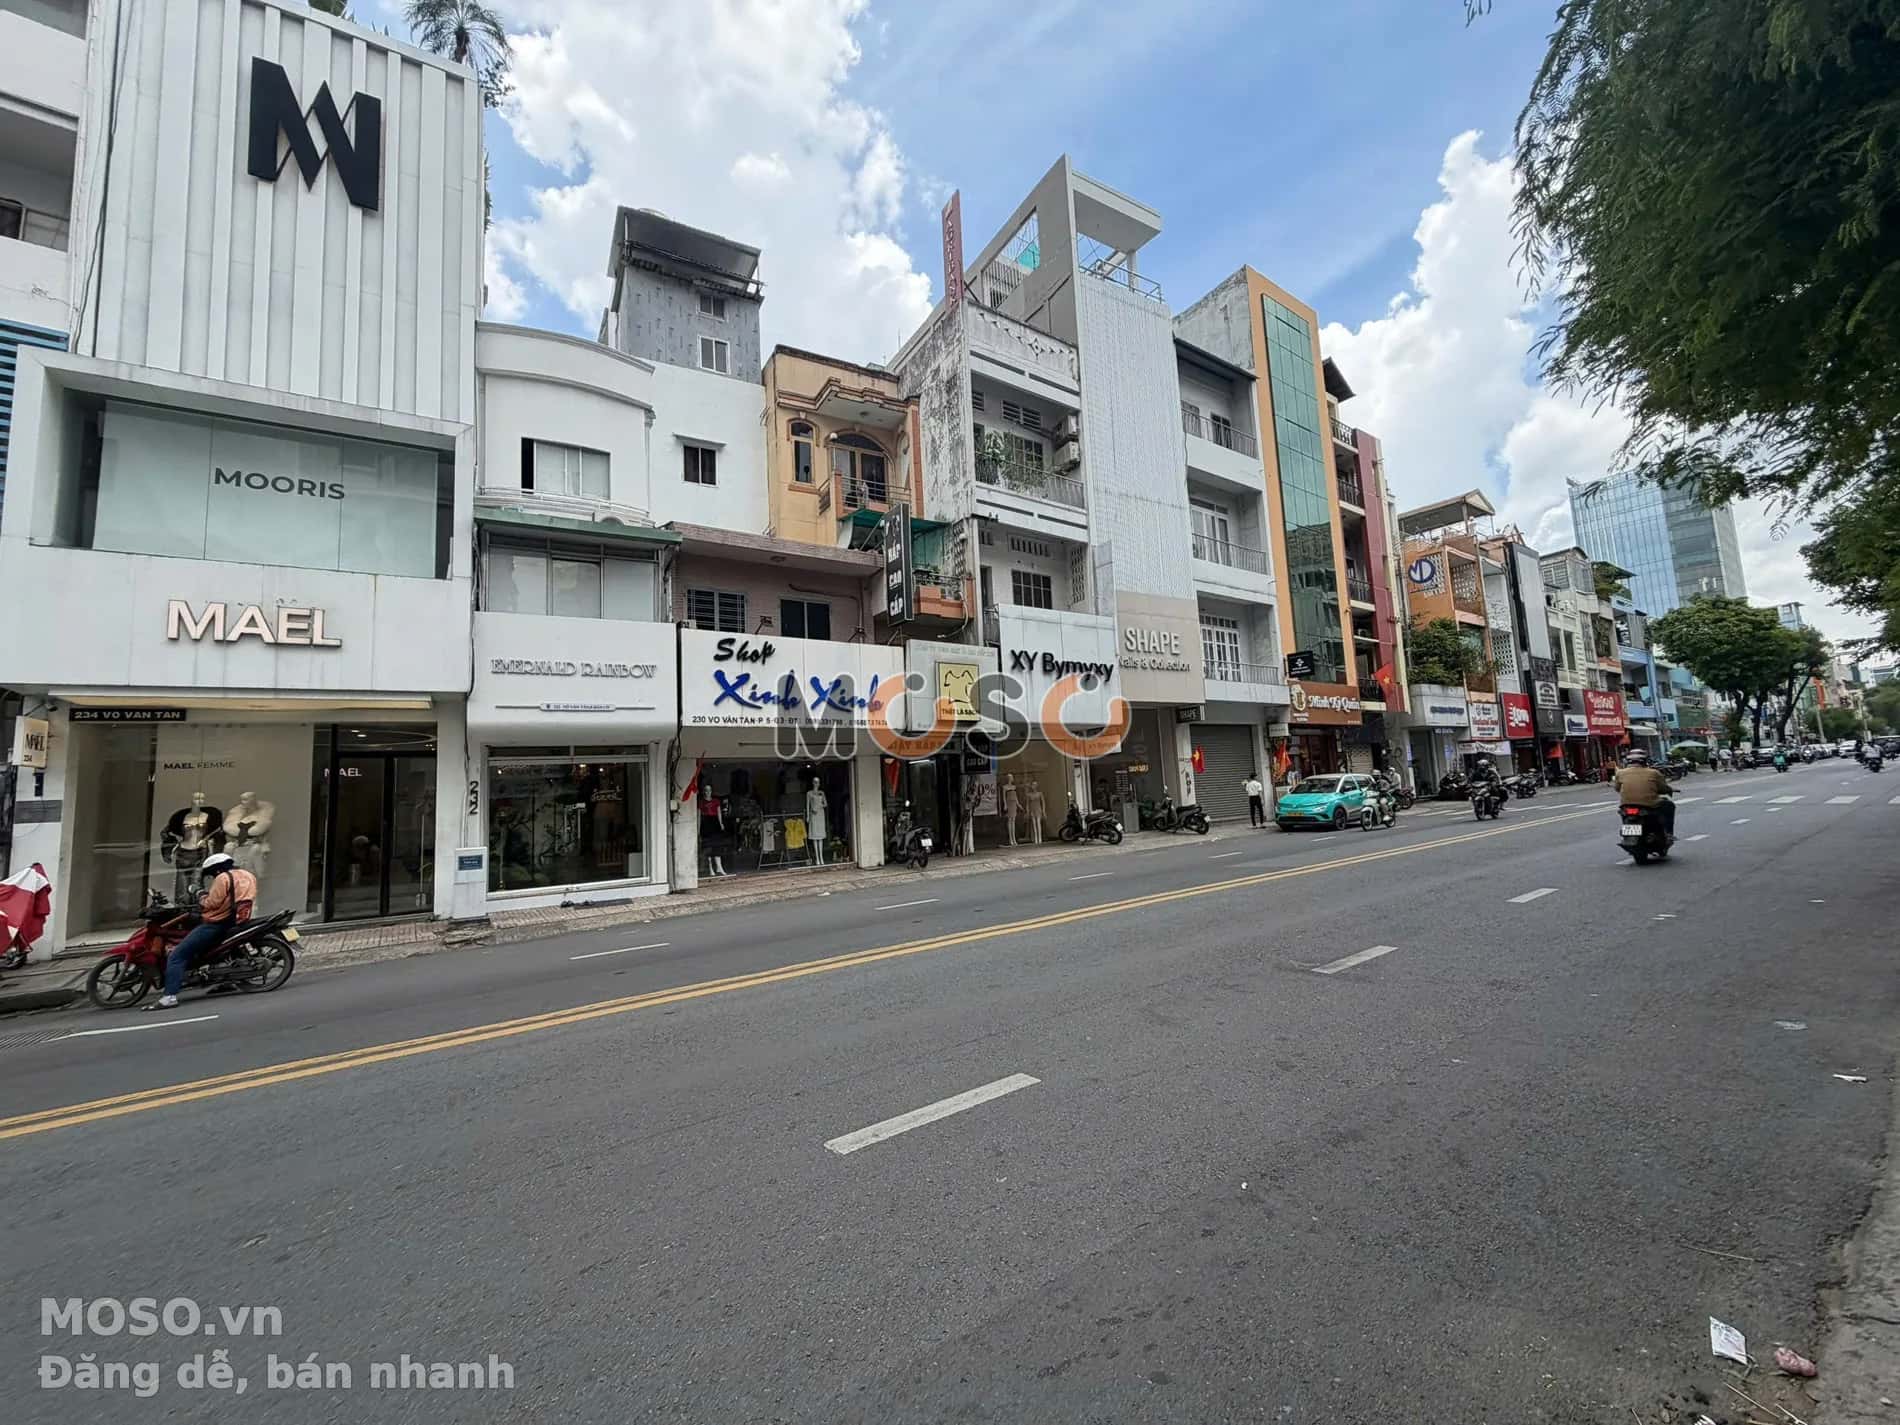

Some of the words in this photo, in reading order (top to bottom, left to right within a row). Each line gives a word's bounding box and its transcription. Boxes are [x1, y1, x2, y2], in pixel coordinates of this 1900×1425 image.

[214, 467, 345, 500] MOORIS
[167, 599, 342, 648] MAEL
[713, 638, 776, 665] Shop
[1125, 627, 1181, 655] SHAPE
[581, 662, 657, 678] RAINBOW
[1010, 649, 1038, 671] XY
[713, 669, 801, 711] Xinh
[810, 673, 884, 713] Xinh
[74, 711, 98, 719] 234
[103, 711, 121, 719] VO
[125, 711, 151, 719] VAN
[154, 711, 181, 719] TAN
[692, 715, 706, 724] 230
[163, 762, 194, 770] MAEL
[197, 761, 235, 769] FEMME
[470, 780, 479, 815] 232
